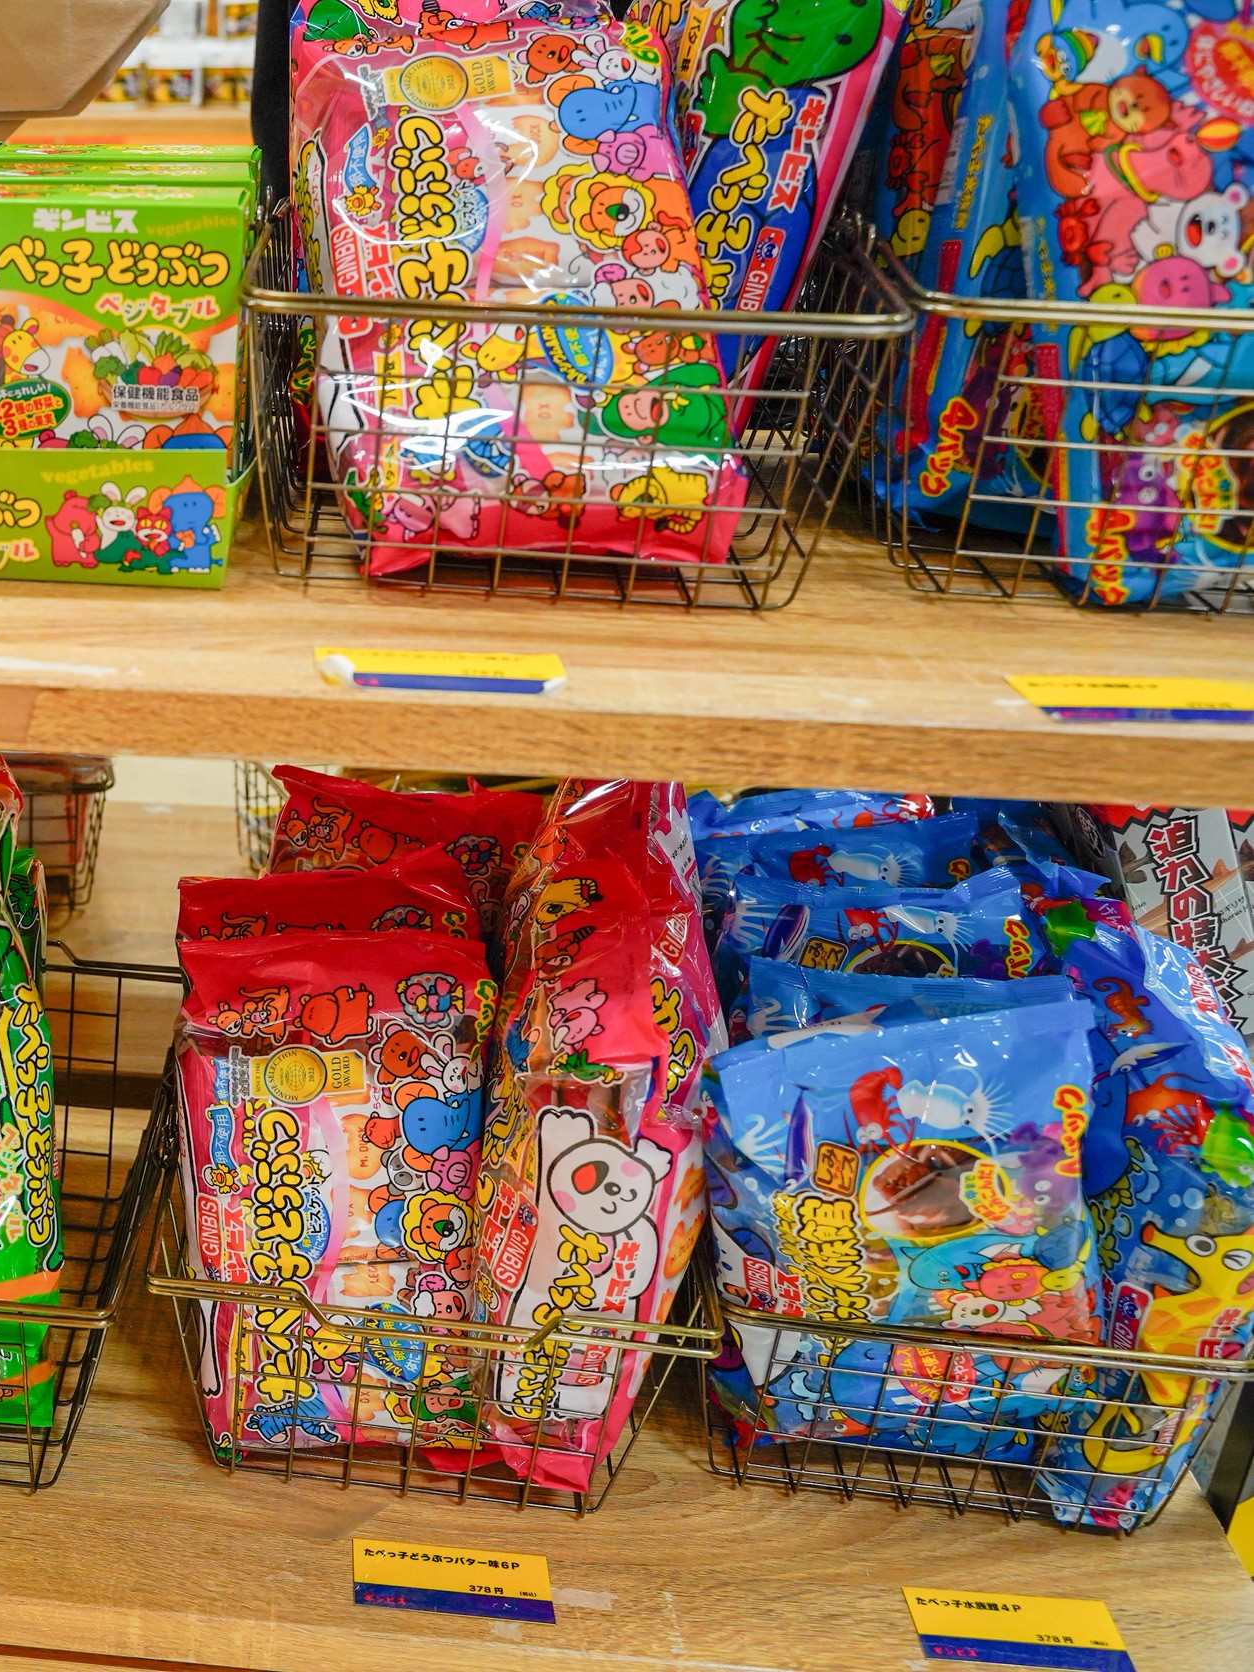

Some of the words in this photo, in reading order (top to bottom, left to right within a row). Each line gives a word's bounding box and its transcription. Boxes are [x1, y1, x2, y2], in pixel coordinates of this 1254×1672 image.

[472, 61, 485, 95] GOLD
[485, 59, 496, 92] AWARD
[768, 96, 825, 213] ギンビス
[33, 208, 138, 234] ギンビス
[147, 215, 237, 238] vegetables
[332, 231, 360, 288] GINBIS
[739, 269, 769, 312] GINB
[96, 293, 219, 327] ベジタブル
[113, 386, 199, 402] 保健機能食品
[41, 459, 154, 484] vegetables
[265, 1049, 297, 1079] SELECTION
[332, 1056, 343, 1089] GOLD
[343, 1055, 351, 1088] AWARD
[13, 982, 54, 1246] たべっ子どうぶつ
[215, 1113, 229, 1165] 卵不使用
[199, 1199, 220, 1256] GINBIS
[223, 1203, 248, 1283] ギンビス
[495, 1228, 530, 1285] GINBIS
[601, 1242, 640, 1314] ギンビス
[364, 1548, 520, 1571] たべっ子どうぶつバター味6P
[362, 1593, 407, 1606] ギンビス
[469, 1584, 504, 1596] 378円
[915, 1596, 1021, 1613] たべっ子水族館4P
[932, 1646, 978, 1658] ギンビス
[1036, 1633, 1074, 1645] 378円
